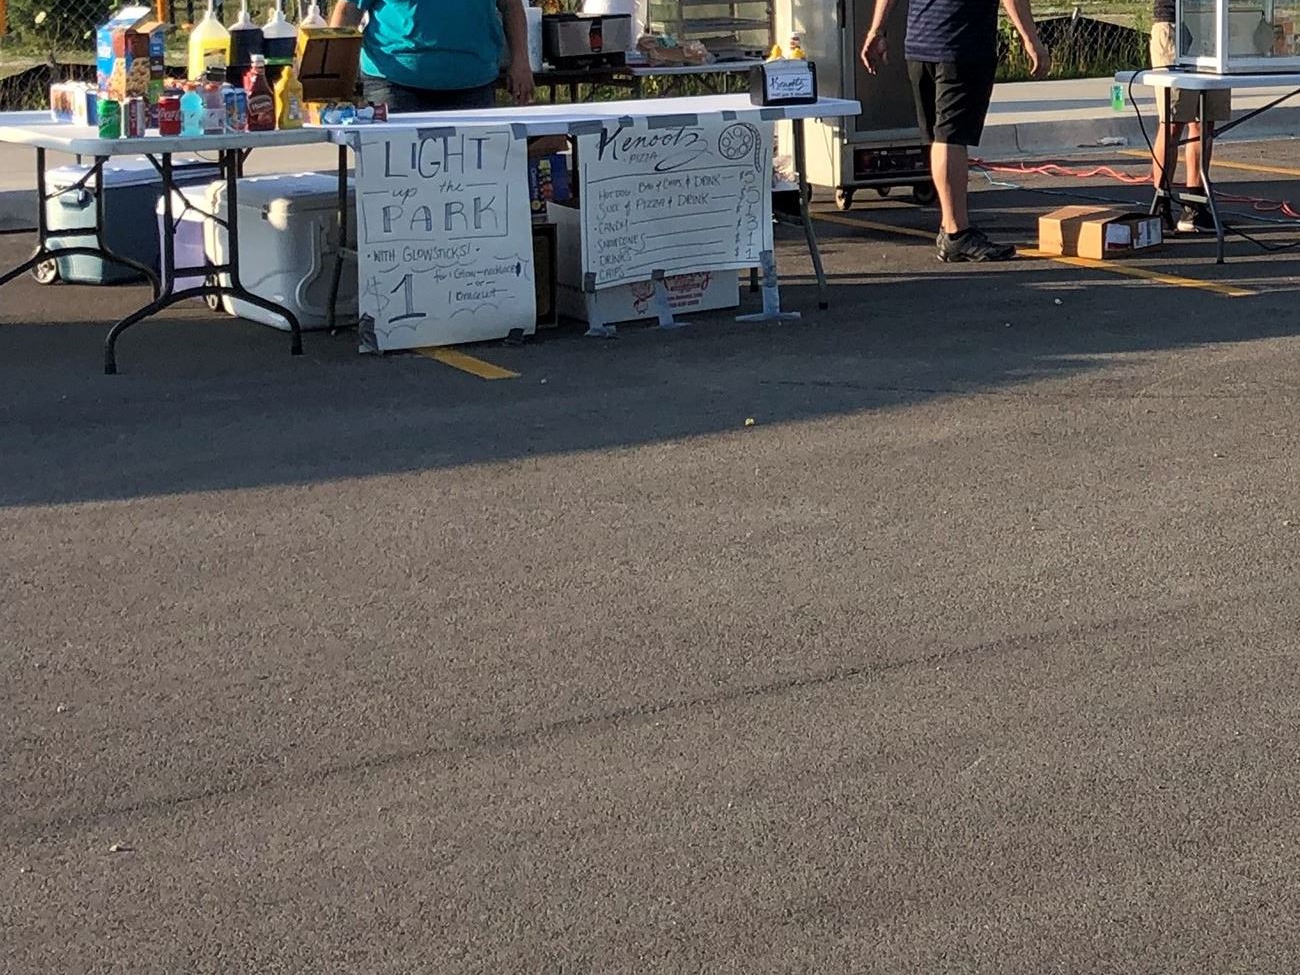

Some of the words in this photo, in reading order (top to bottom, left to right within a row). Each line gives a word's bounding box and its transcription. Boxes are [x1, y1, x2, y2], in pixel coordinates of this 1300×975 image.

[385, 133, 491, 179] LIGHT
[392, 186, 418, 205] up
[438, 180, 465, 193] the
[382, 195, 499, 234] PARK
